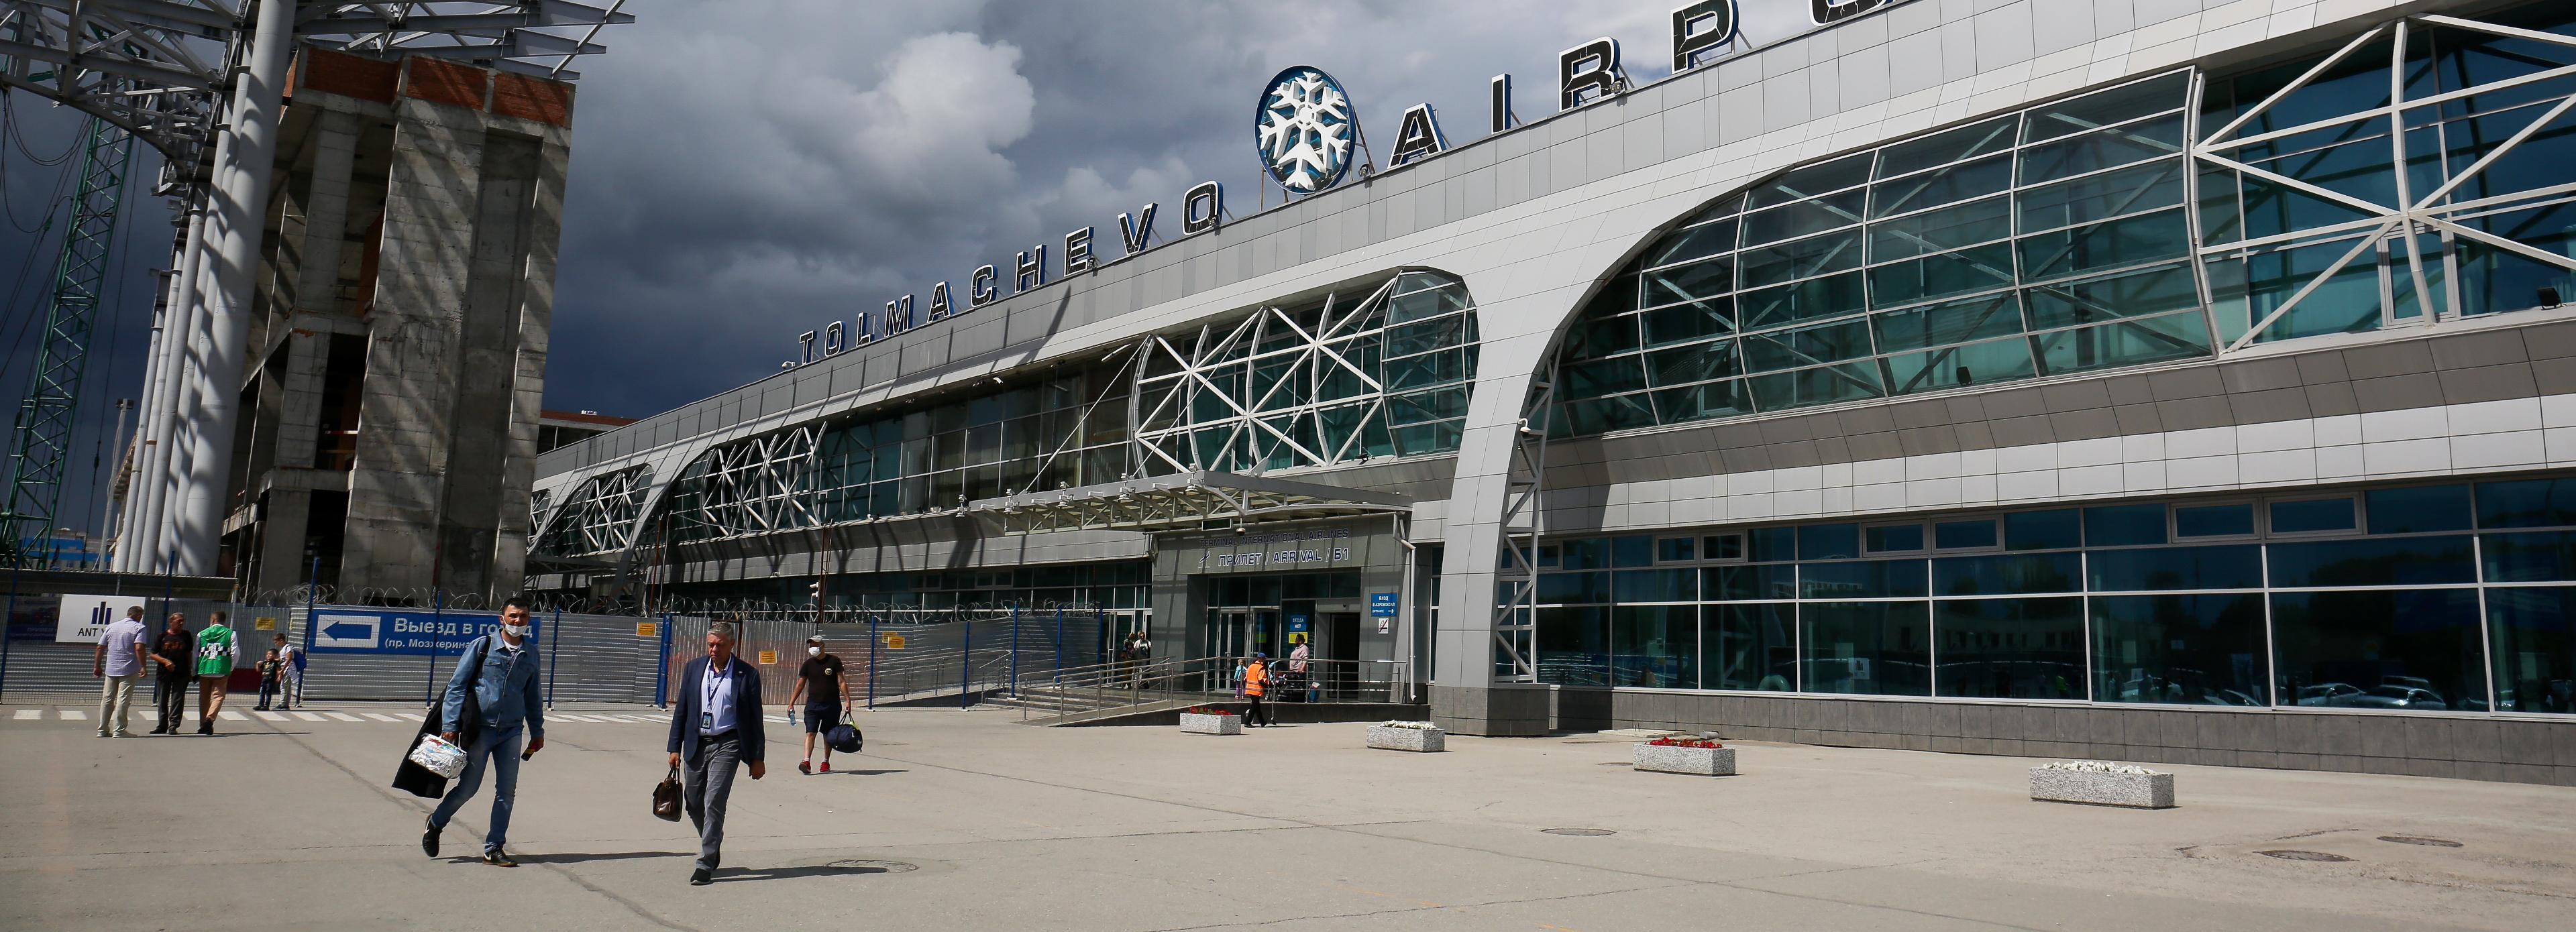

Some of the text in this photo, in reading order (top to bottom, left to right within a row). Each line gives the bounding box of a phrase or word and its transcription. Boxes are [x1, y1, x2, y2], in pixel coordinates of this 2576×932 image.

[798, 0, 1898, 365] TOLMACHEVO AIRP
[1201, 528, 1348, 547] TERMINAL INTERNATIONAL AIRLINES
[1218, 552, 1262, 567] ПРИЛЕТ
[1273, 548, 1322, 564] ARRIVAL
[1333, 547, 1348, 561] Б1
[77, 628, 99, 637] ANT
[394, 618, 533, 638] Выезд в год
